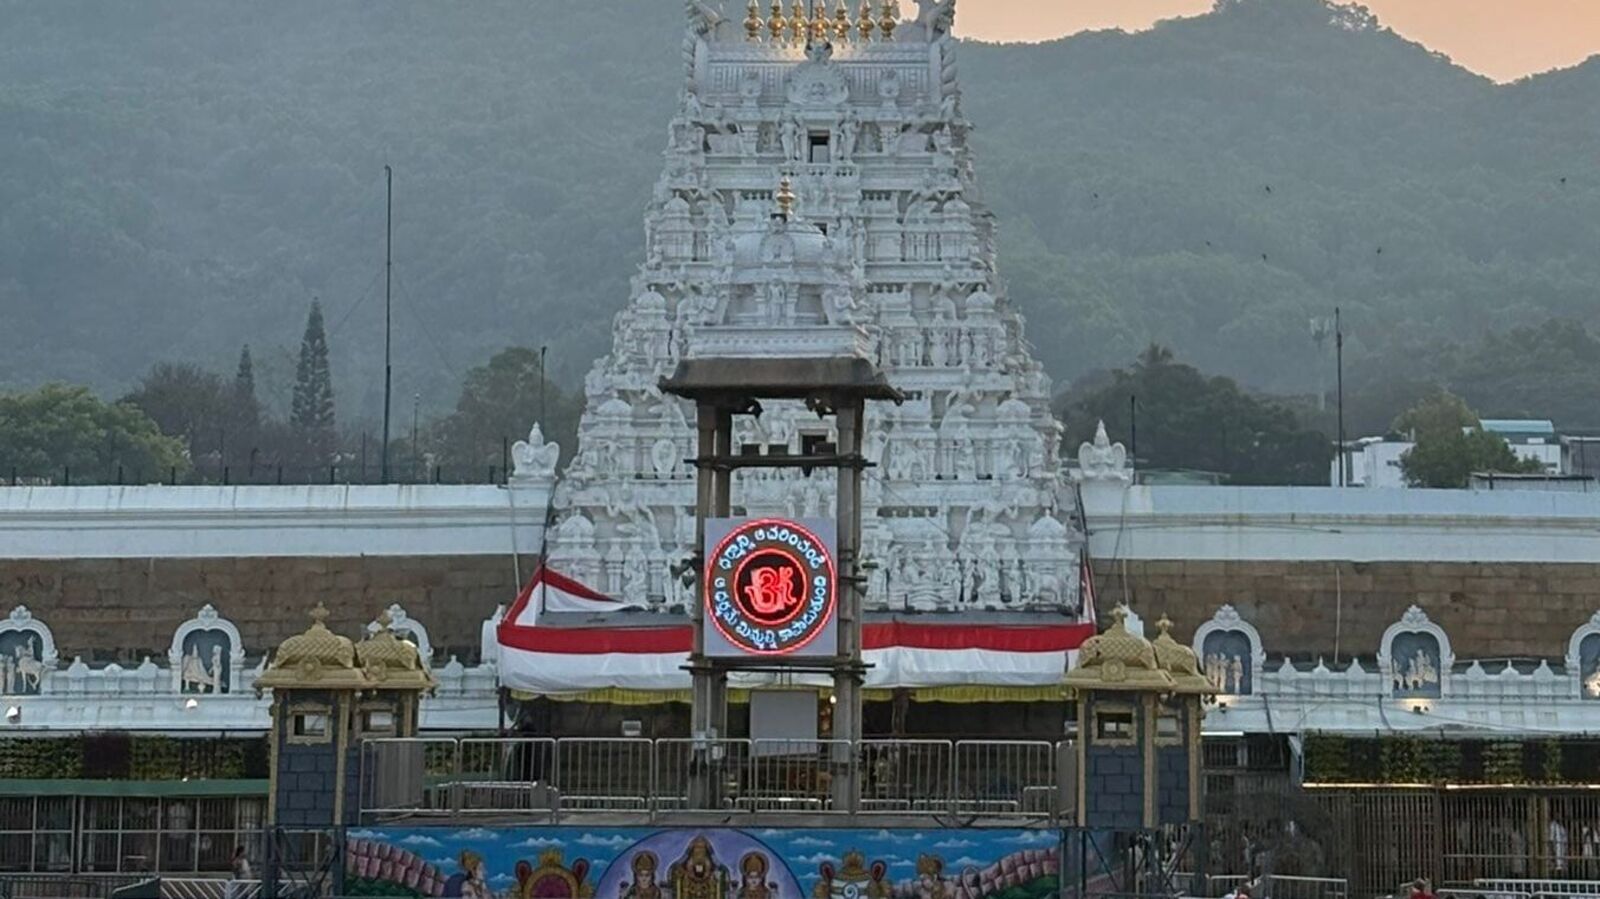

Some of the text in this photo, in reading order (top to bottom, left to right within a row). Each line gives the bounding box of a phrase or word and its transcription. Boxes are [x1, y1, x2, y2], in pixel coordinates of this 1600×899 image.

[719, 525, 826, 570] ధర్మాన్ని ఆచరించండి
[778, 575, 827, 642] కాపాడుతుంది
